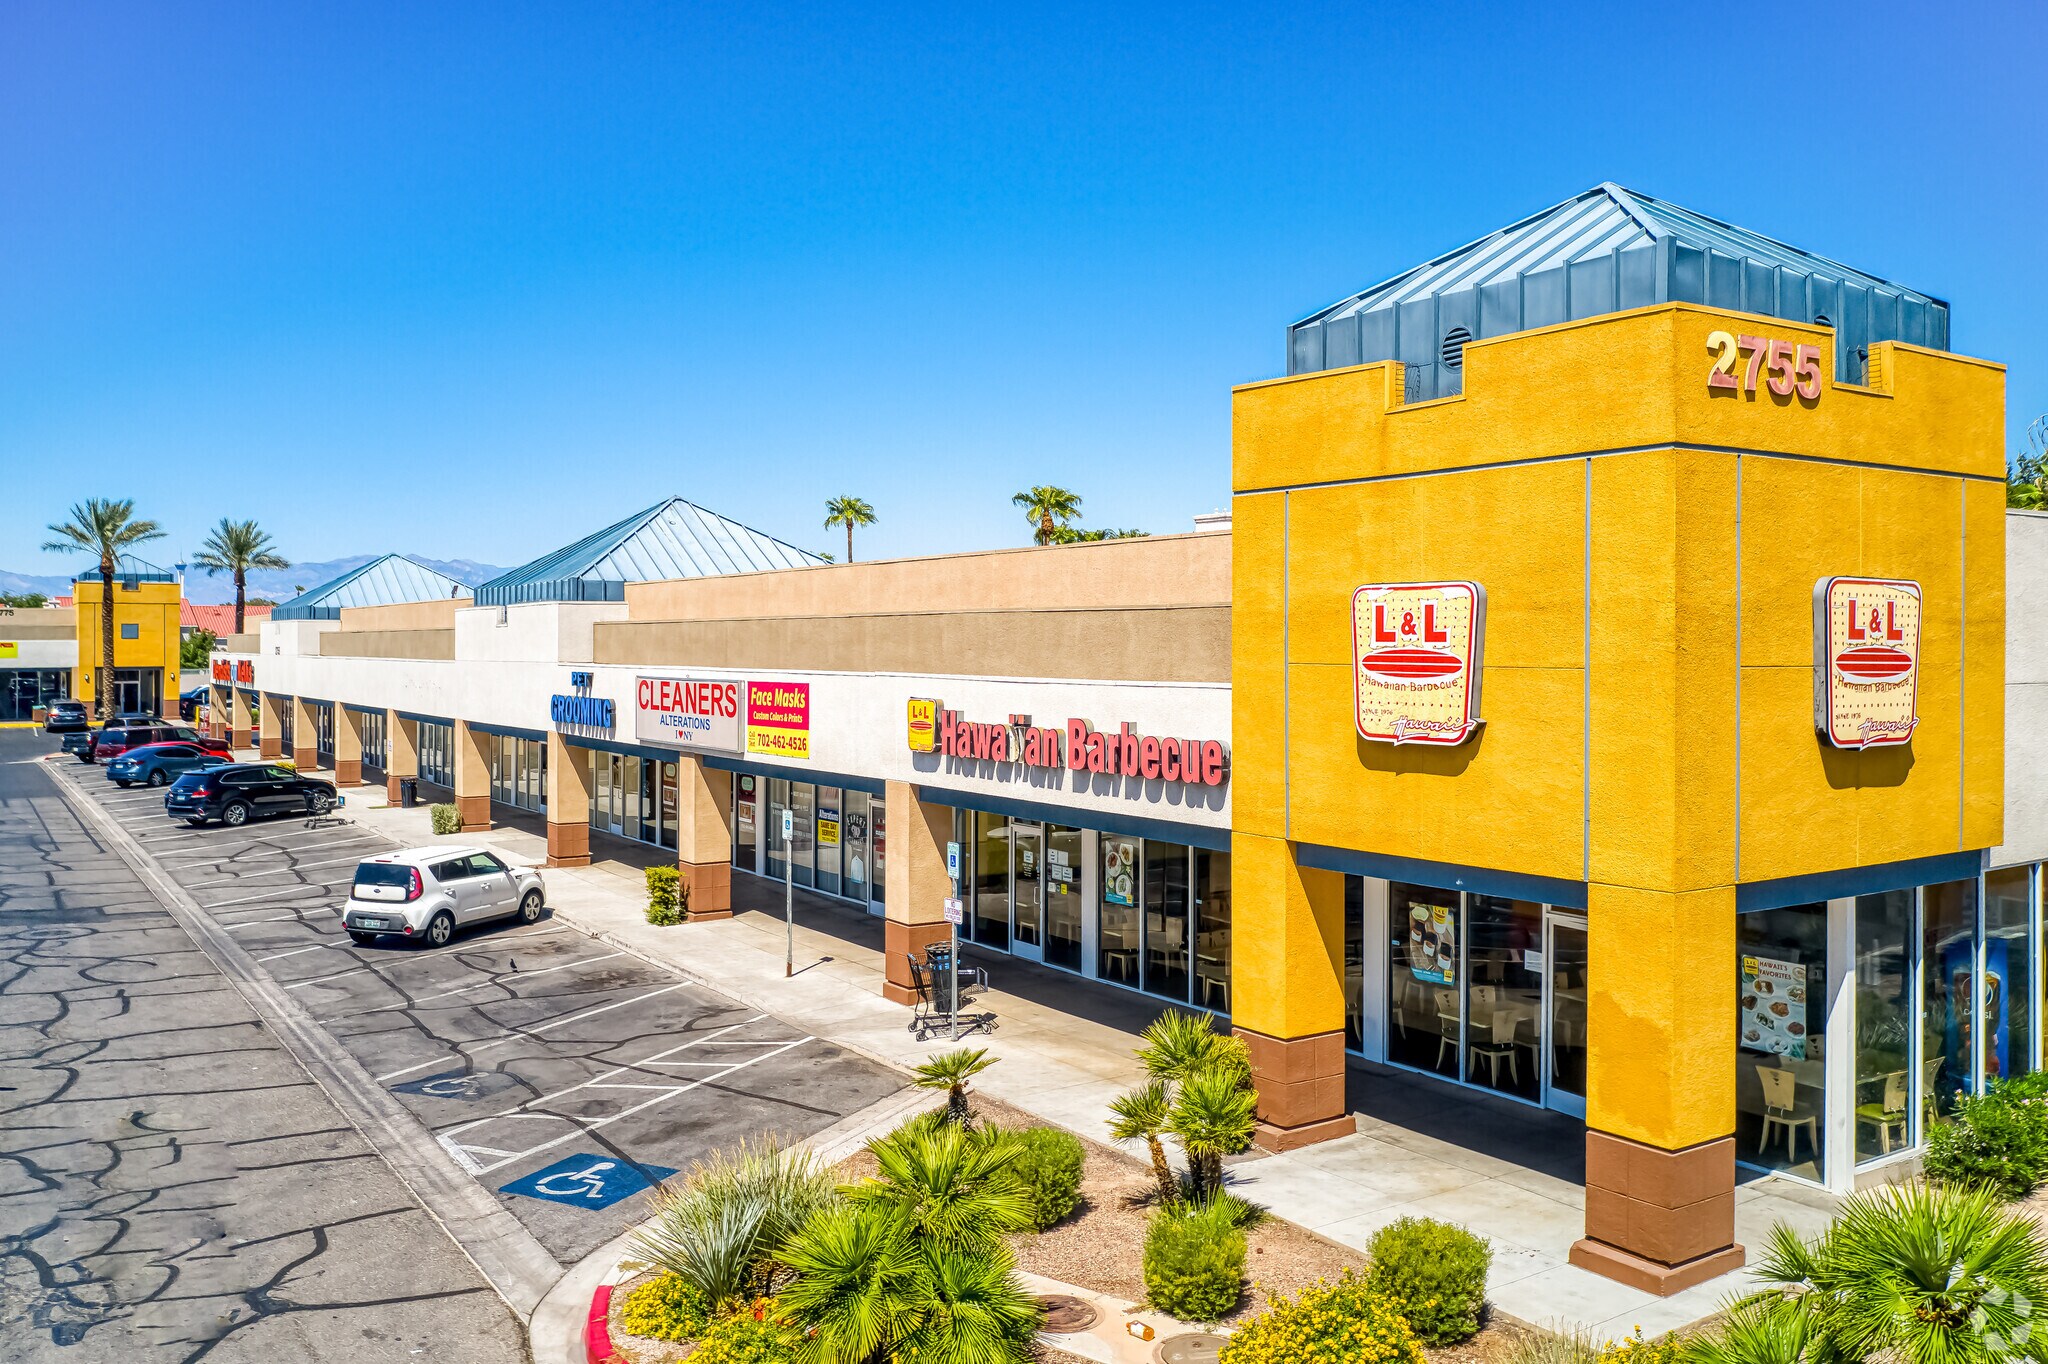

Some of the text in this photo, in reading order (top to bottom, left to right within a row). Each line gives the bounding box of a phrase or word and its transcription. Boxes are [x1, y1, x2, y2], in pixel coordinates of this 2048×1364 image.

[1706, 331, 1821, 399] 2755
[572, 672, 589, 687] PET
[1410, 679, 1458, 692] Barbecue
[638, 680, 737, 718] CLEANERS
[751, 687, 806, 709] Face Masks
[551, 694, 612, 729] GROOMING
[753, 711, 769, 721] Custom
[770, 712, 783, 722] Colors
[788, 713, 803, 723] Prints
[660, 714, 711, 731] ALTERATIONS
[1390, 715, 1475, 742] Hawaii
[1858, 715, 1919, 746] Hawaii
[757, 733, 807, 752] 702-462-4526
[1067, 718, 1223, 786] Barbecue
[819, 808, 839, 822] Alterations
[820, 821, 830, 830] SAME
[1760, 961, 1788, 971] HAWAII'S
[1760, 969, 1792, 980] FAVORITES
